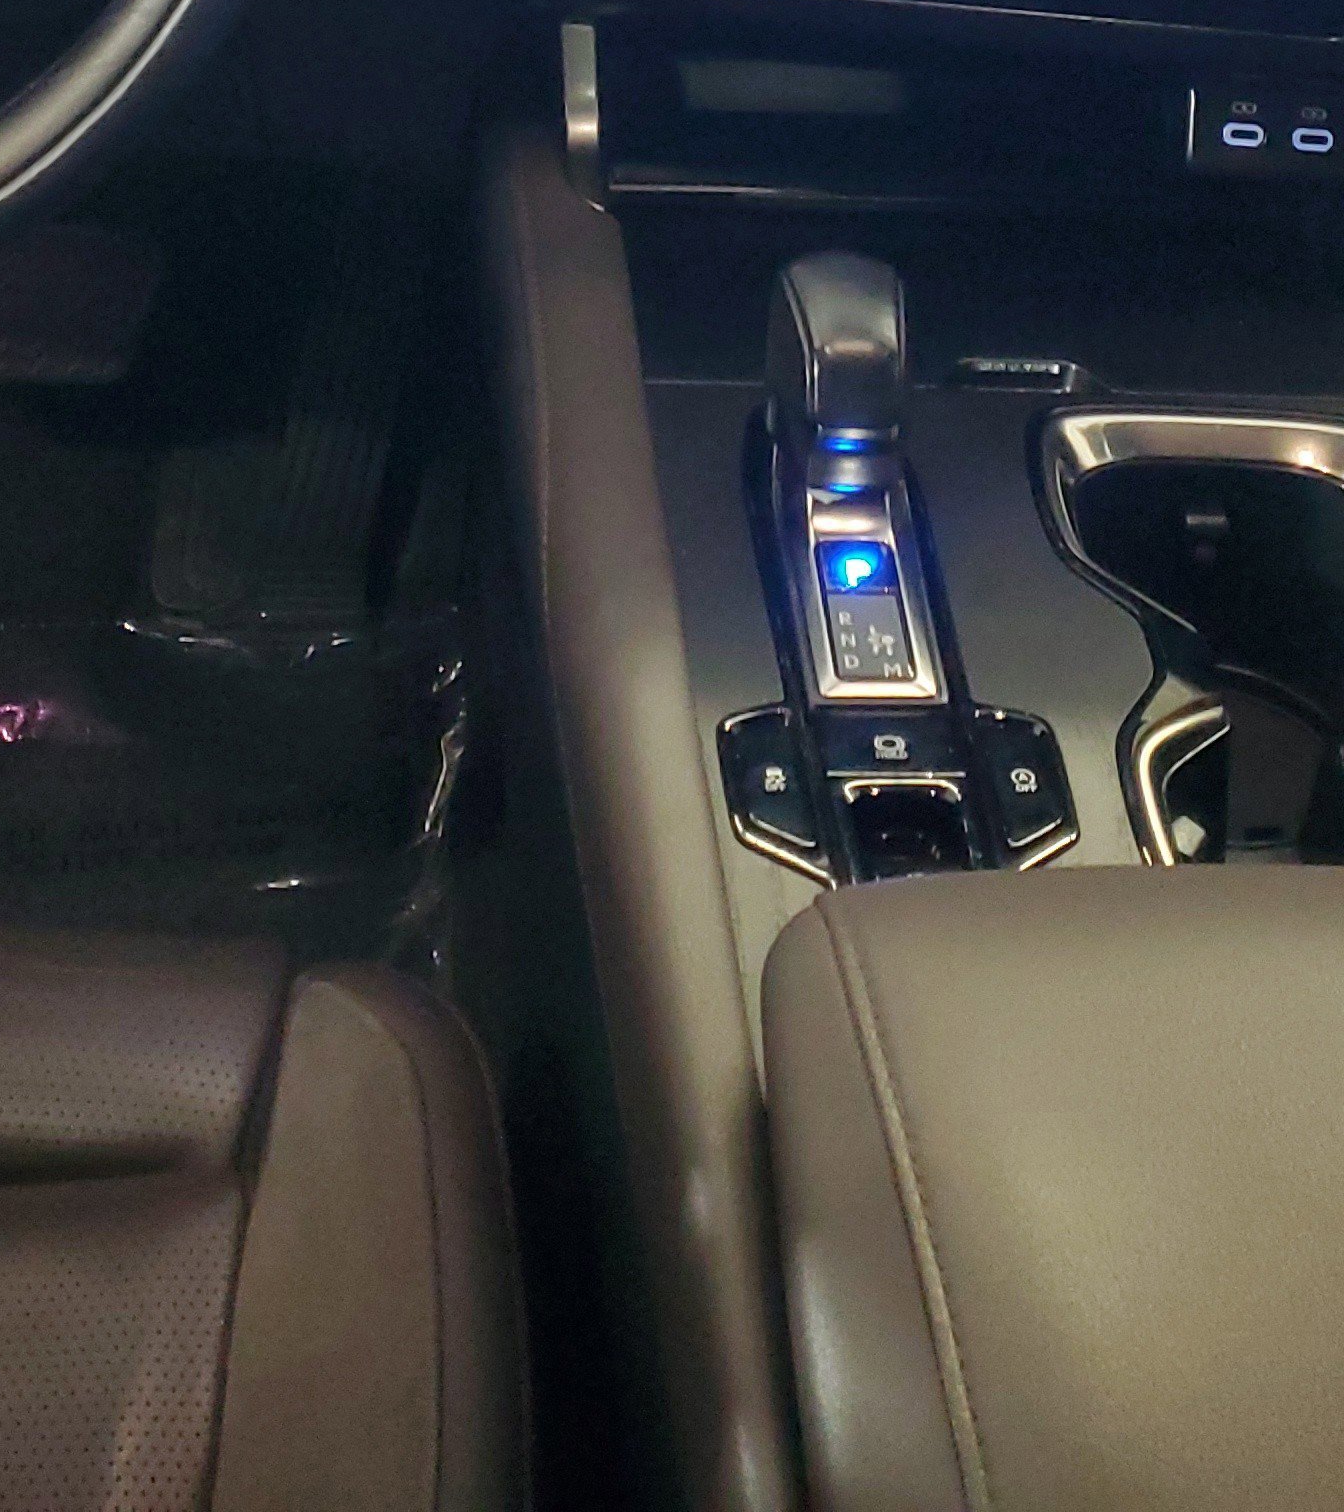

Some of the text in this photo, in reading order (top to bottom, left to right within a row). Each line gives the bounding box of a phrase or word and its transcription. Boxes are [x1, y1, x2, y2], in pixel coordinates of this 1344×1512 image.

[844, 557, 873, 588] P
[838, 611, 853, 627] R
[840, 633, 856, 648] N
[844, 654, 859, 670] D
[883, 663, 902, 678] M
